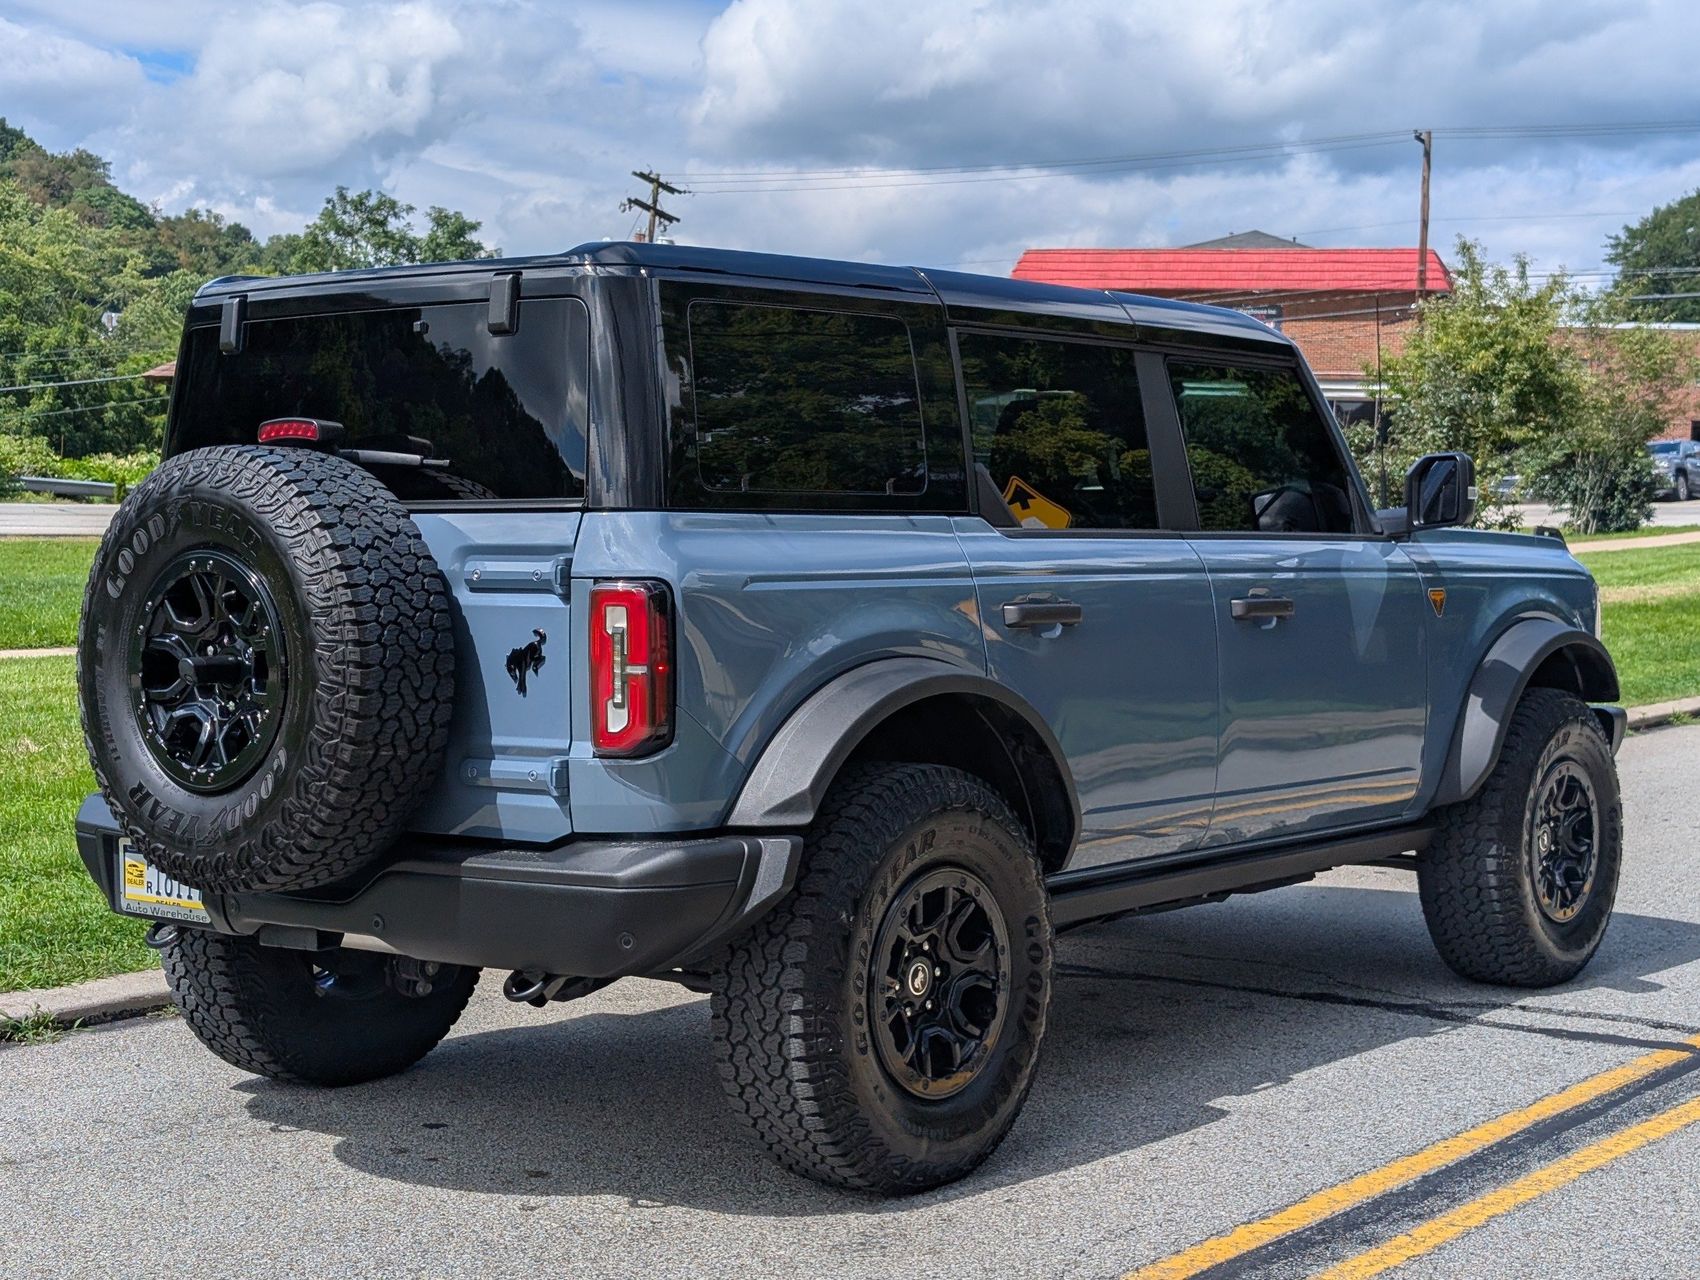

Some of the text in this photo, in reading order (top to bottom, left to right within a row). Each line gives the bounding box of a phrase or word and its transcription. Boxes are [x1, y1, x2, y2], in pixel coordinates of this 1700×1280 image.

[106, 494, 263, 599] GOODYEAR
[127, 877, 145, 886] DEALER
[125, 902, 208, 922] Auto Warehouse
